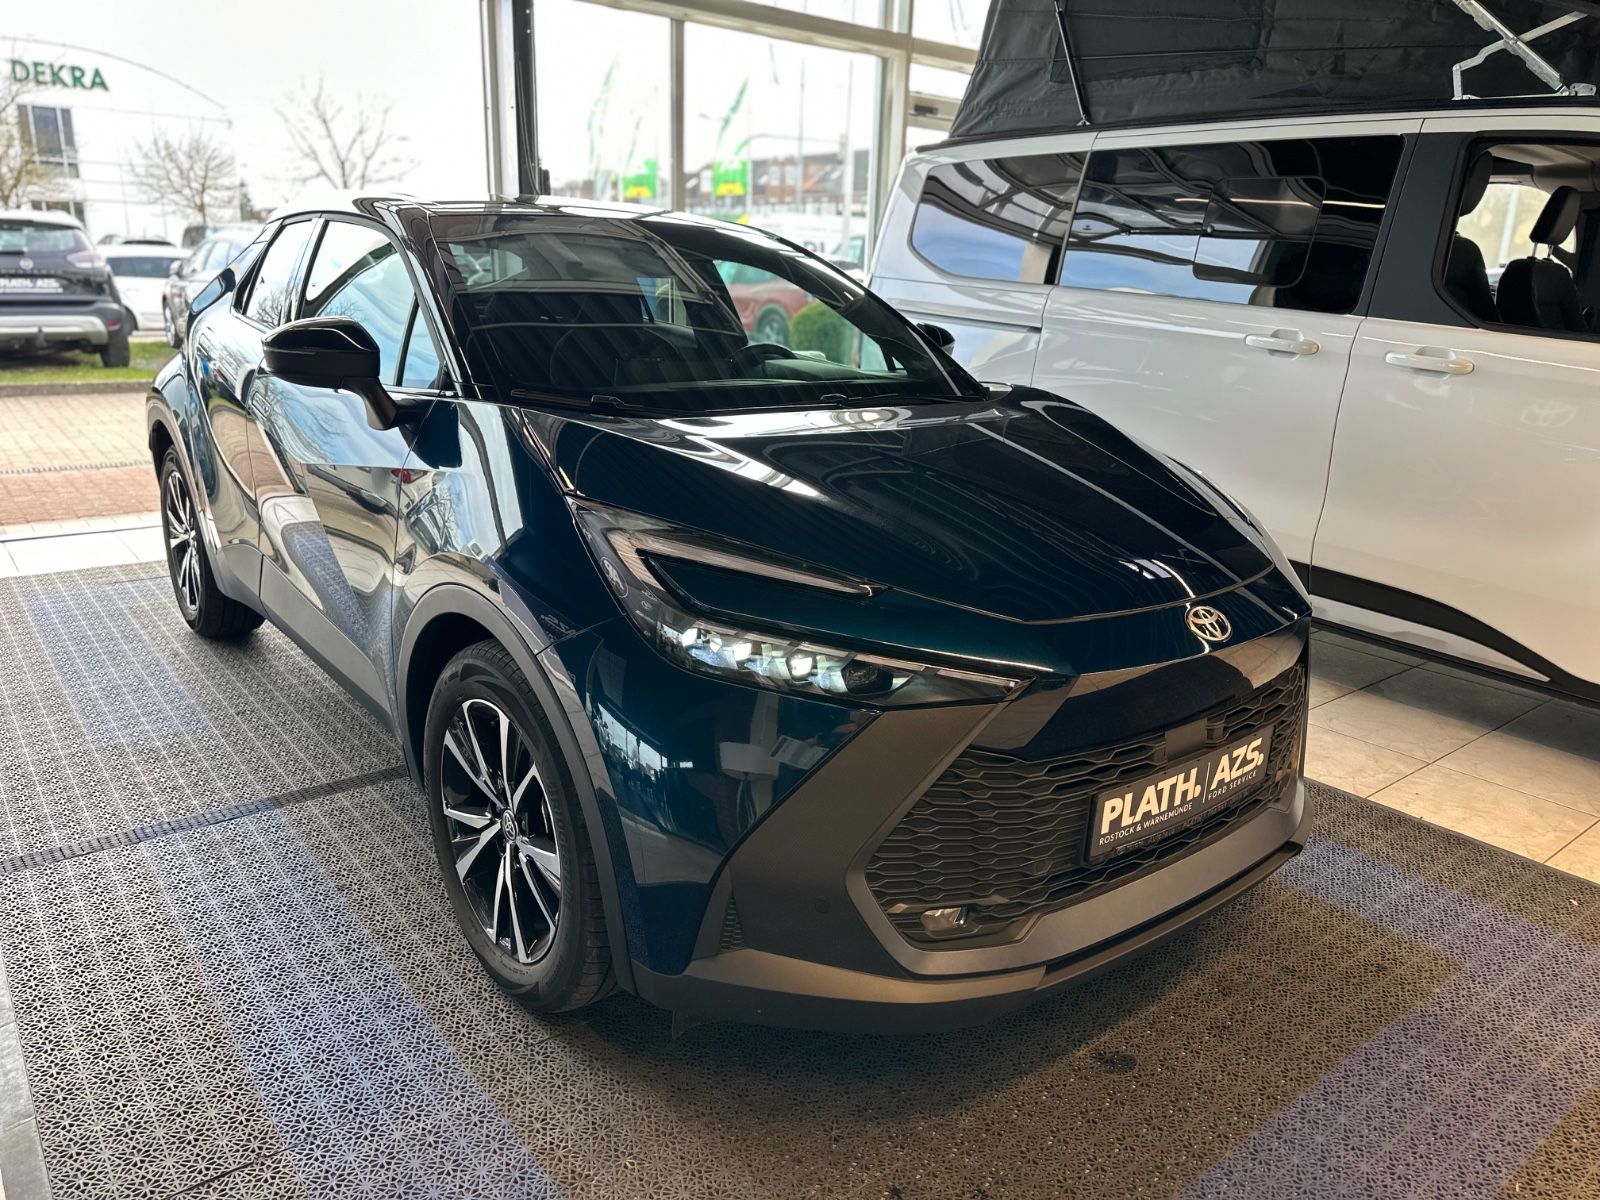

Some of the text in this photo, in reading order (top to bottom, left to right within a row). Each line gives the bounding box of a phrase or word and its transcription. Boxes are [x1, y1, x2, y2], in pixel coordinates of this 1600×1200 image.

[10, 59, 109, 91] DEKRA
[1208, 770, 1257, 800] FORD SERVICE
[1098, 826, 1135, 846] ROSTOCK
[1136, 823, 1142, 832] &
[1143, 802, 1193, 829] WARNEMÜNDE
